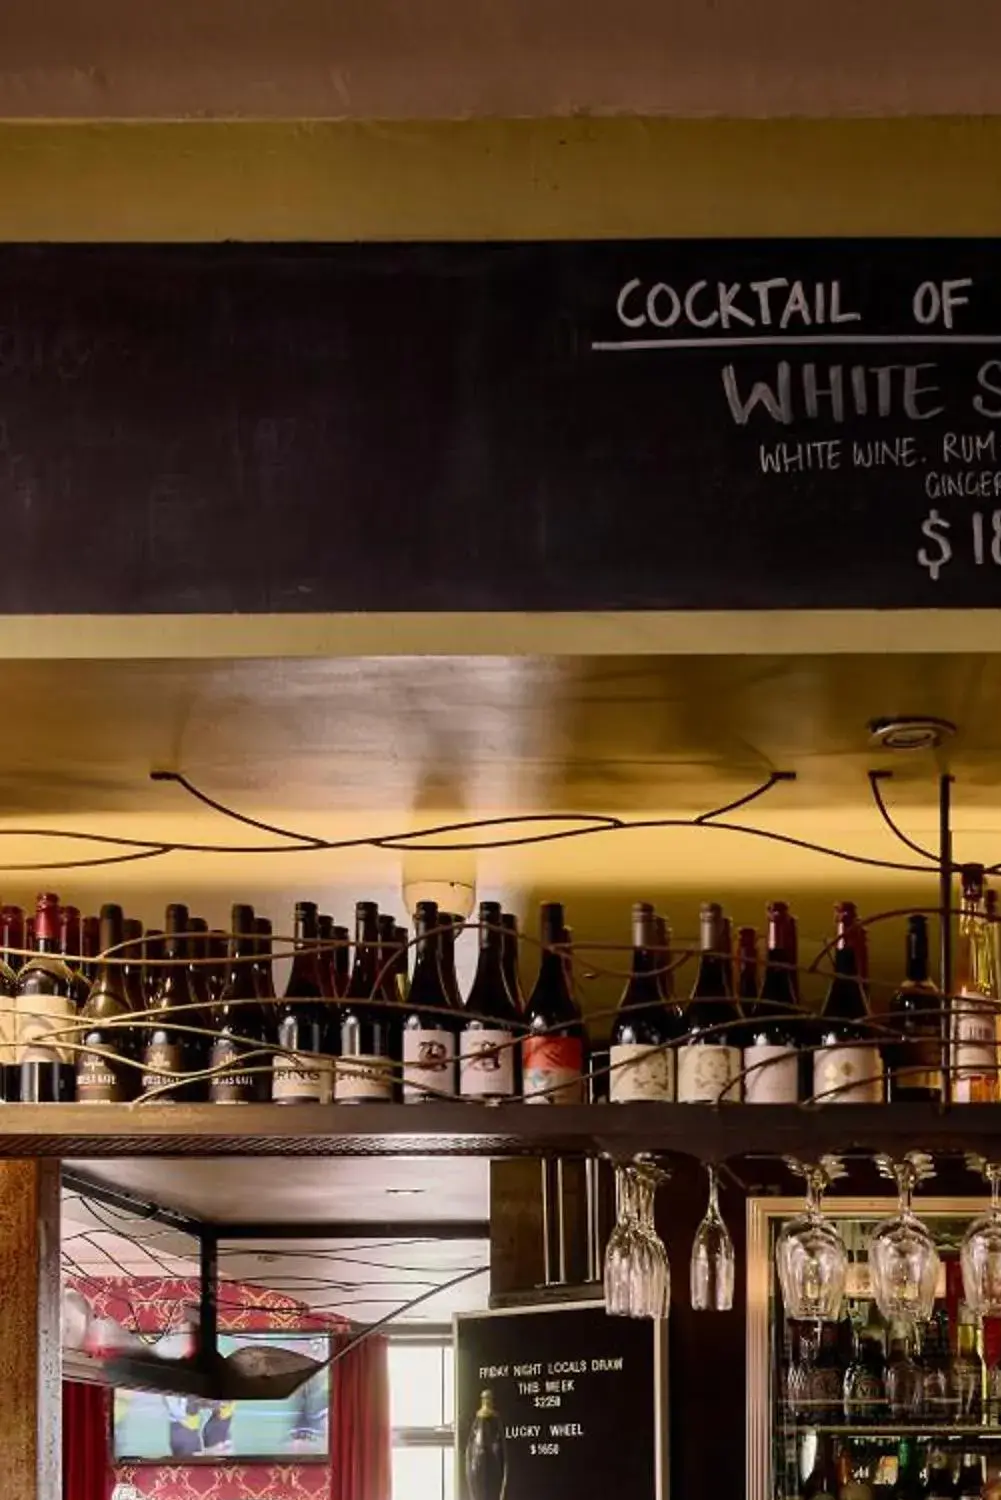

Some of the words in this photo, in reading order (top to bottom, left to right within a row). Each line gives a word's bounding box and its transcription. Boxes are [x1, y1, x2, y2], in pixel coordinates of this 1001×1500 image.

[616, 277, 861, 329] COCKTAIL
[912, 277, 973, 329] OF
[721, 360, 943, 425] WHITE
[759, 439, 841, 473] WHITE
[548, 1361, 587, 1374] LOCALS
[591, 1358, 624, 1371] DRAW
[545, 1379, 576, 1393] WEEK
[505, 1426, 541, 1439] LUCKY
[549, 1424, 584, 1437] WHEEL
